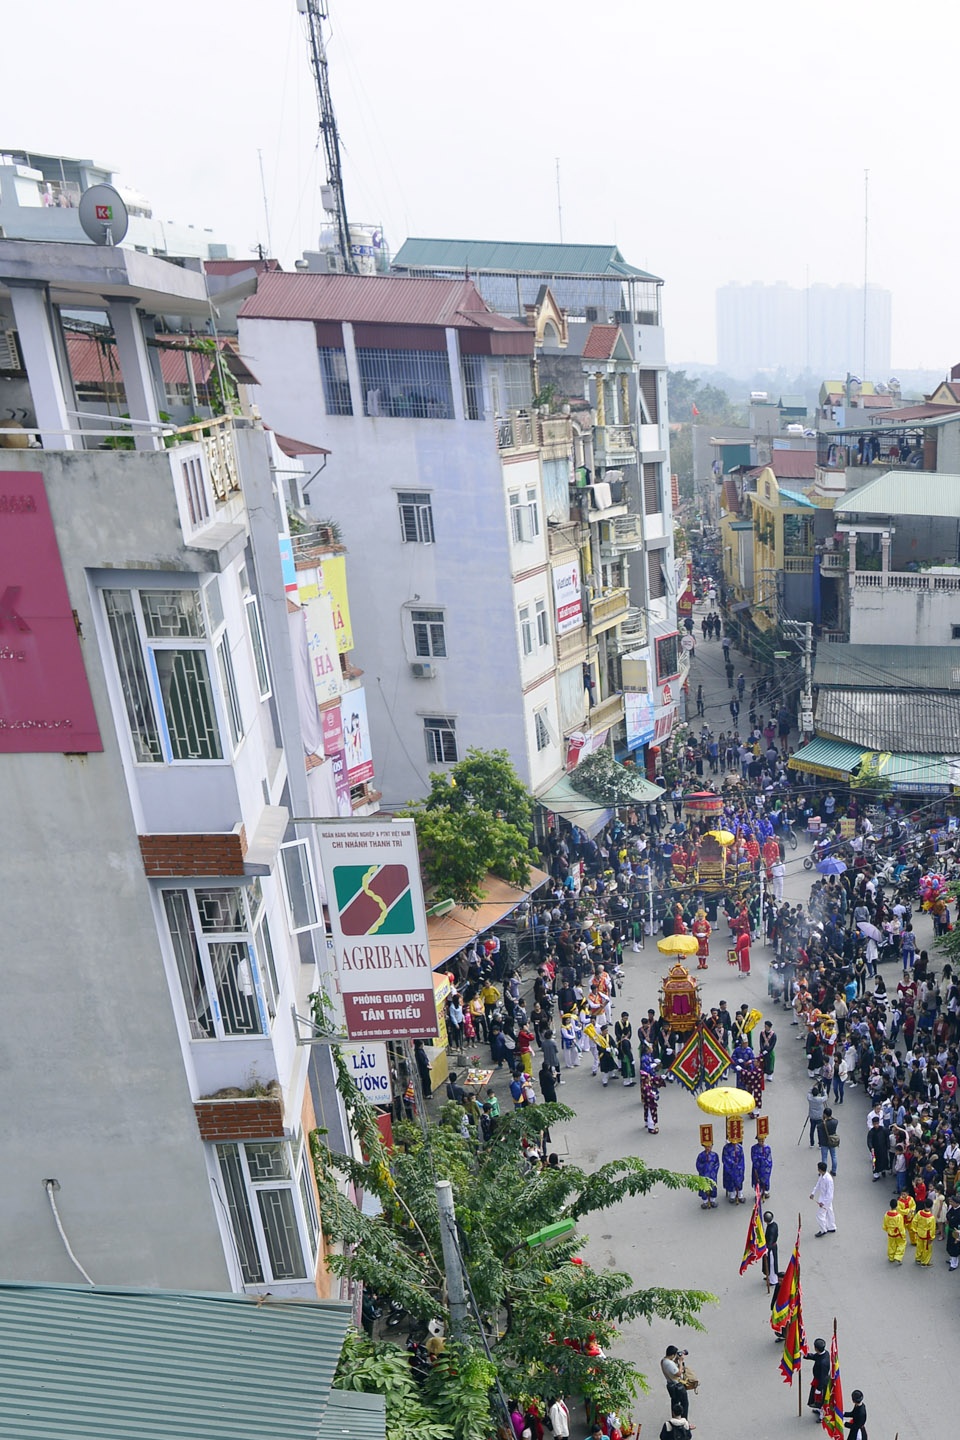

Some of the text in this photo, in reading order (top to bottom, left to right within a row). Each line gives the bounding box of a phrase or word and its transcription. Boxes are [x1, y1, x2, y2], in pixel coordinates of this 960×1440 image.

[332, 841, 343, 849] CHI
[369, 840, 390, 848] THANH
[342, 944, 428, 971] AGRIBANK
[352, 993, 425, 1005] PHÒNG GIAO DỊCH
[360, 1008, 385, 1021] TÂN
[352, 1046, 376, 1069] LẨU
